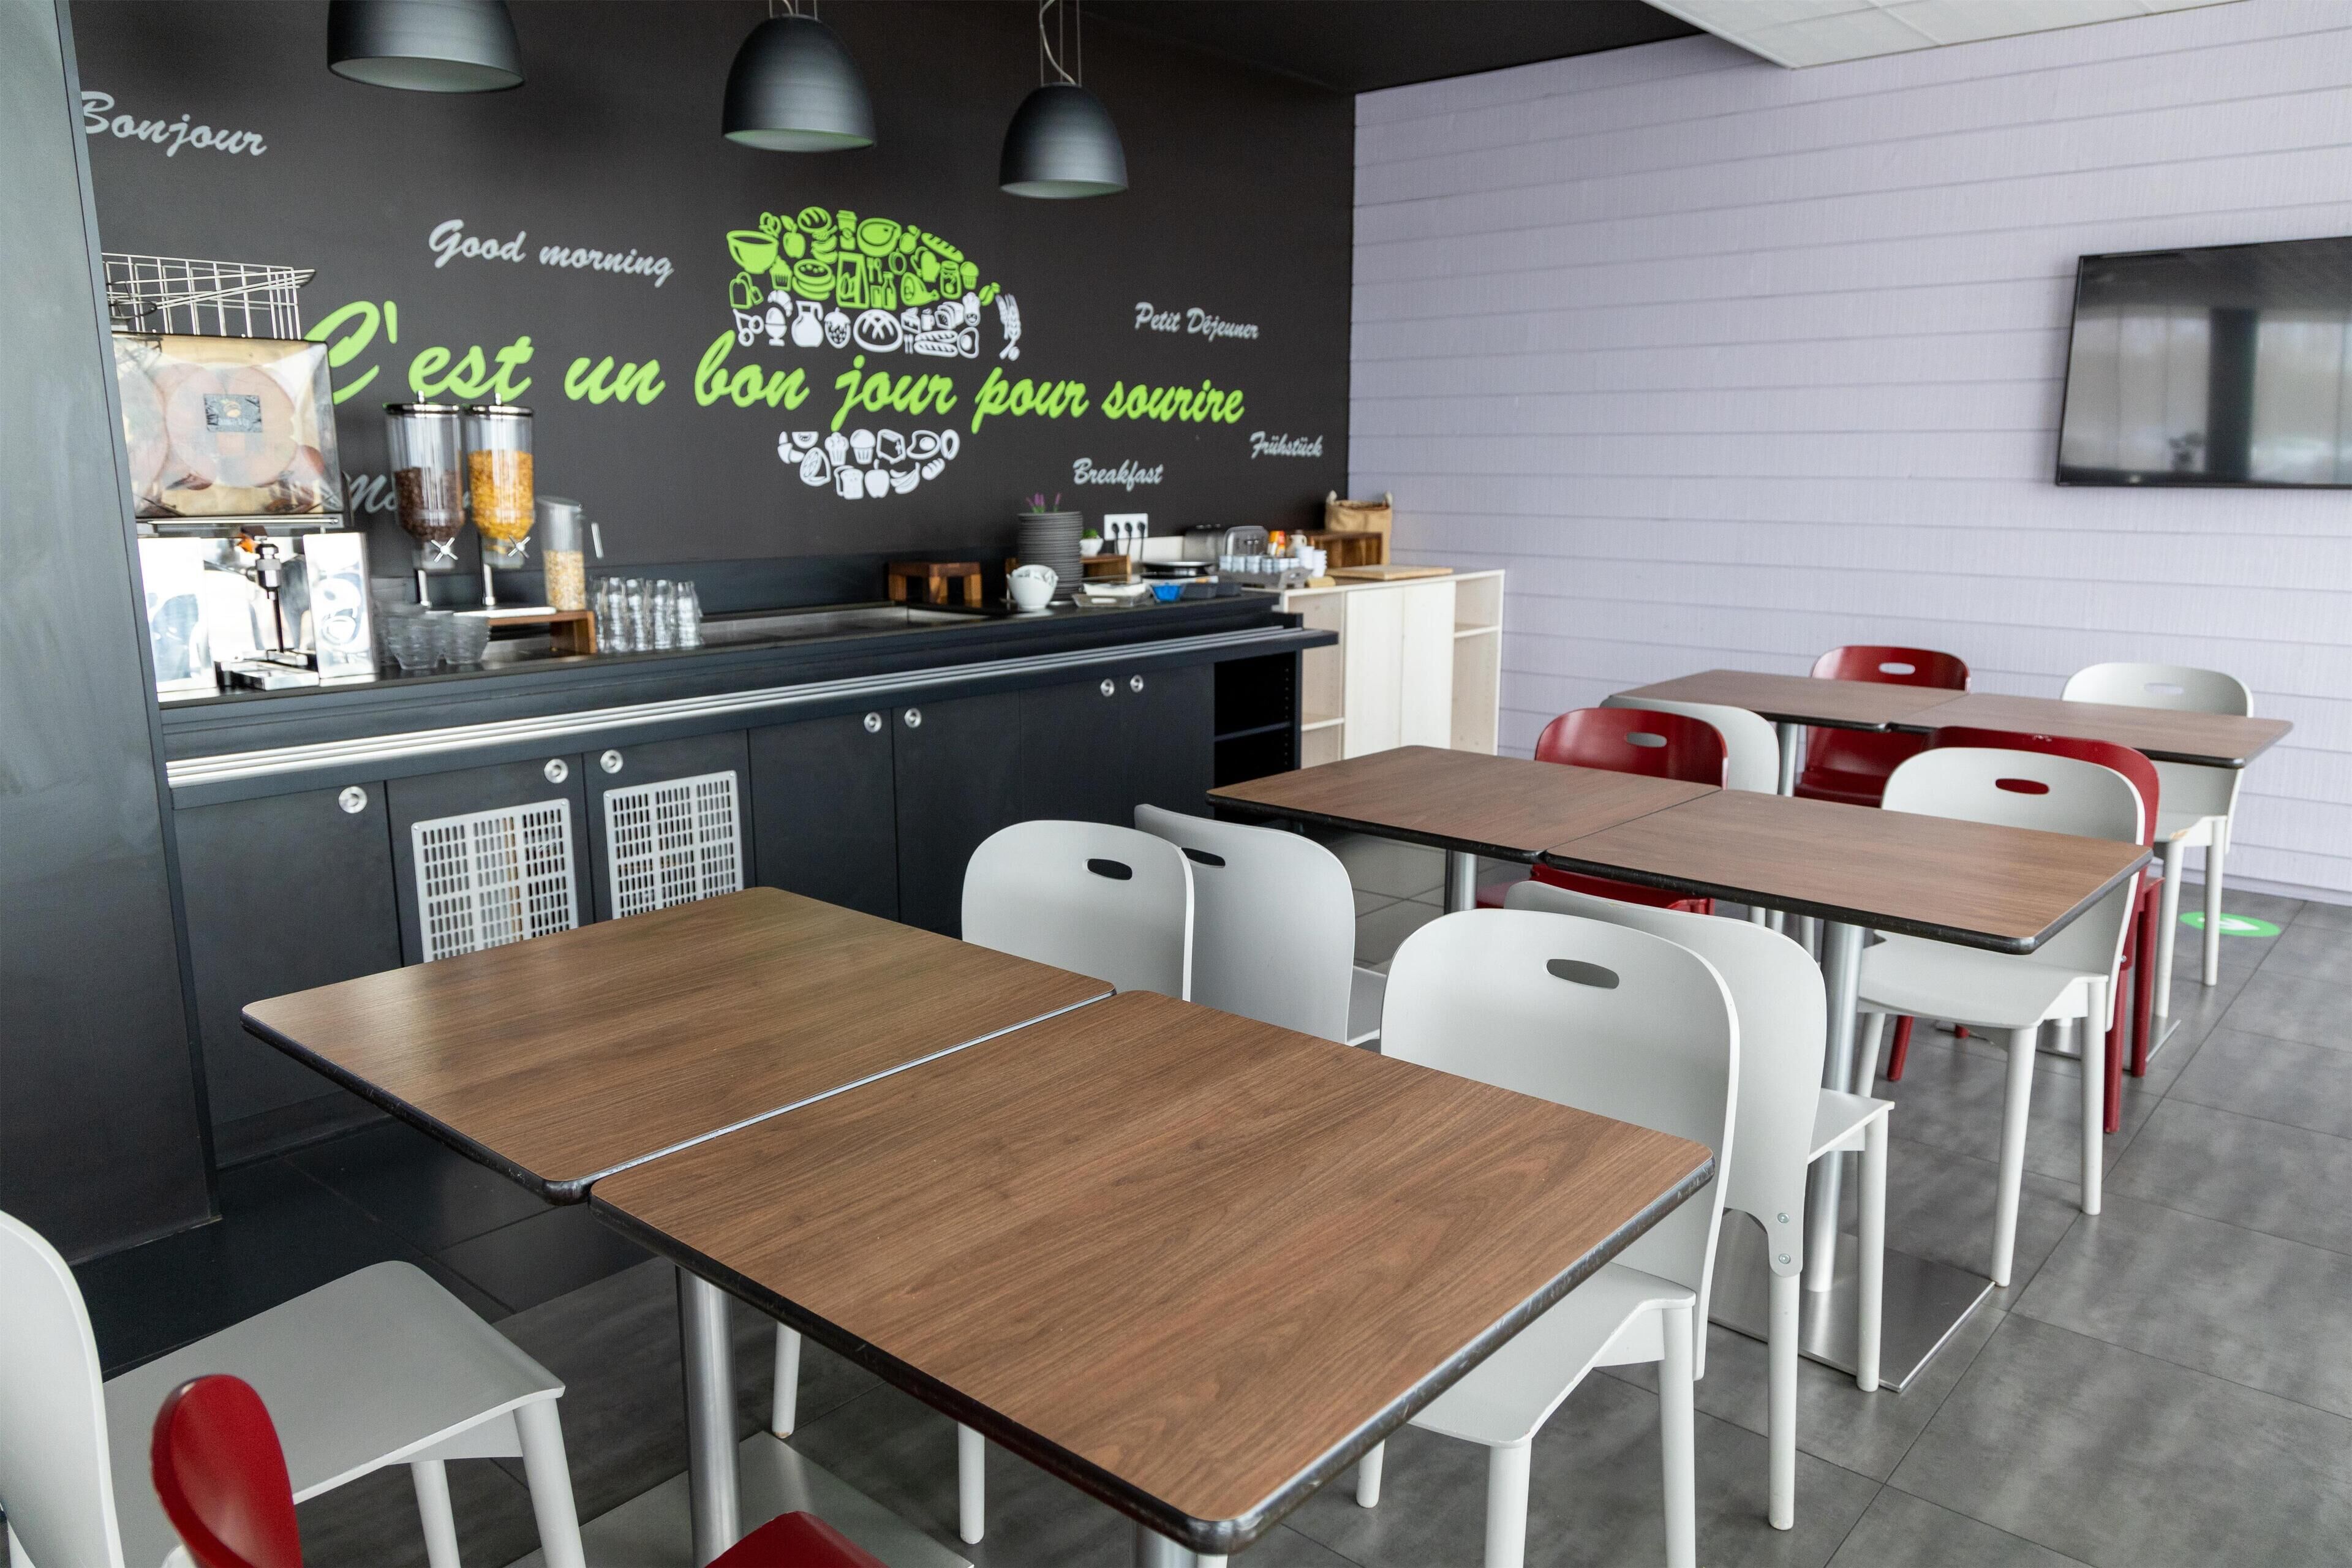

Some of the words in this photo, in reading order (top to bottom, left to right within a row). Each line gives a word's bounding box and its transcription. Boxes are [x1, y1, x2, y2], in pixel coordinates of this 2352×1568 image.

[80, 91, 268, 157] Bonjour
[428, 219, 527, 268] Good
[539, 245, 674, 288] morning
[1134, 301, 1182, 333] Petit
[304, 300, 534, 405] C'est
[564, 356, 666, 405] un
[694, 329, 810, 411] bon
[830, 354, 958, 432] jour
[971, 366, 1090, 434] pour
[1101, 379, 1245, 424] sourire
[1249, 431, 1324, 459] Frühstück
[1072, 457, 1164, 492] Breakfast
